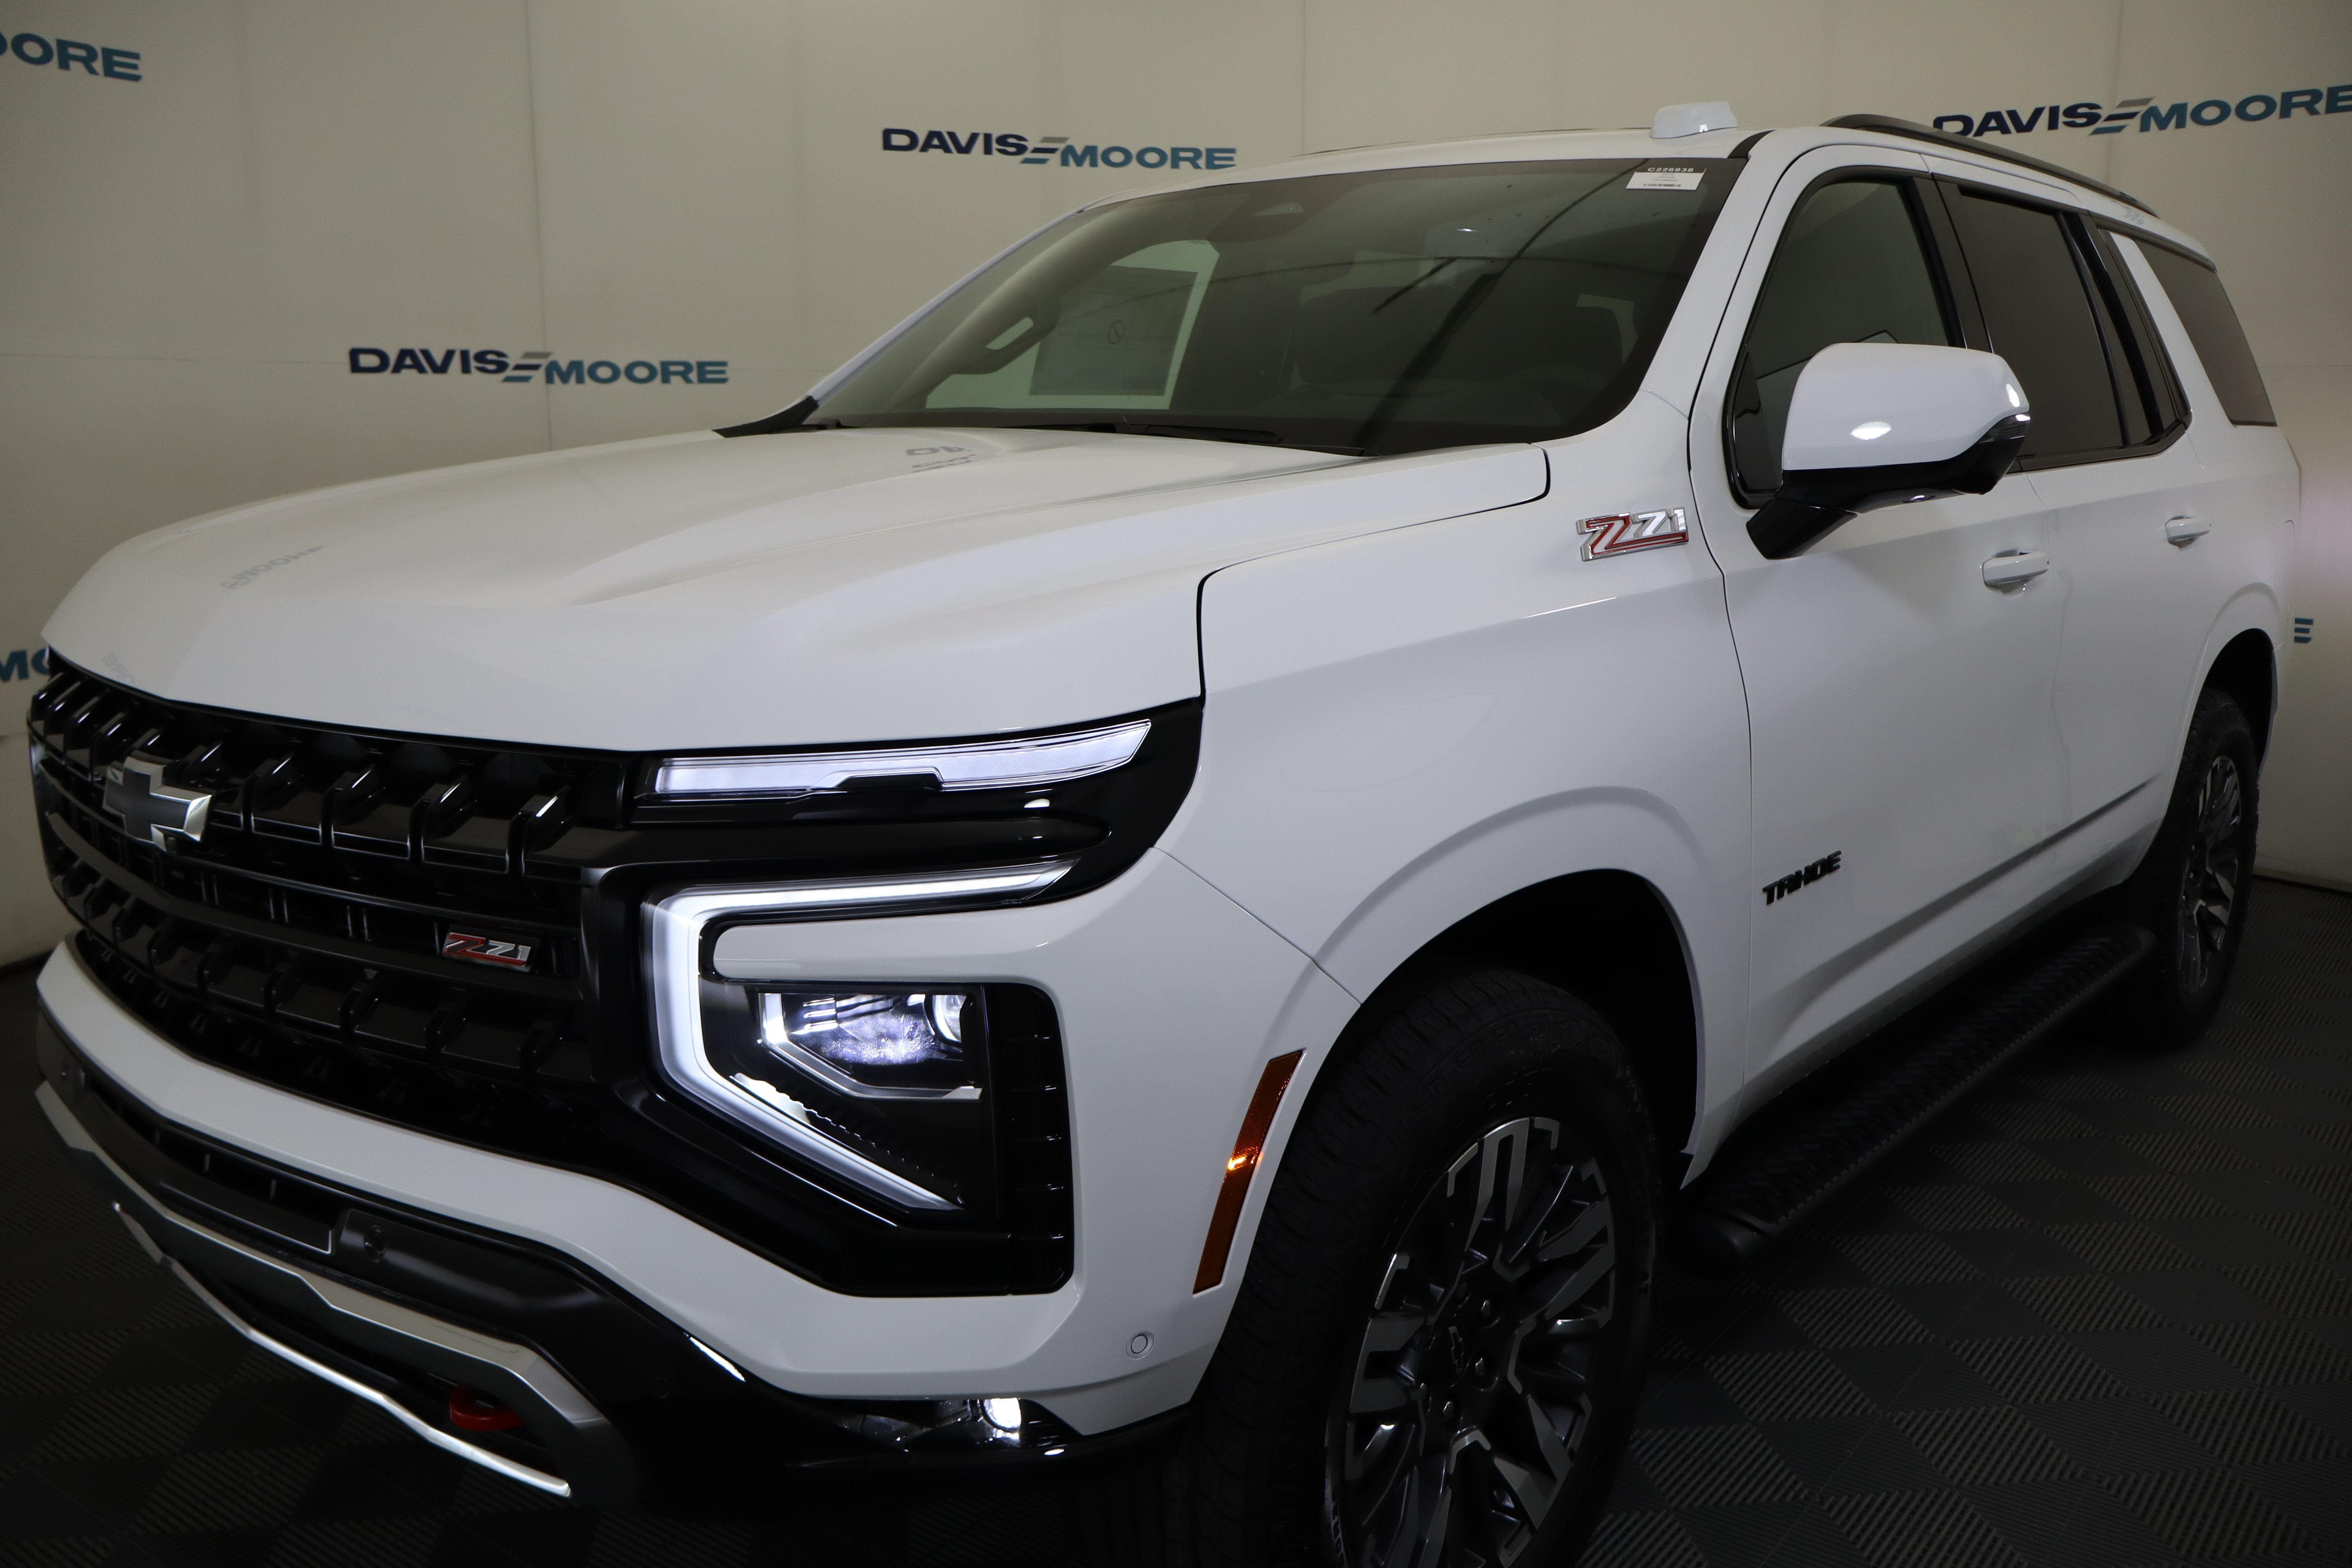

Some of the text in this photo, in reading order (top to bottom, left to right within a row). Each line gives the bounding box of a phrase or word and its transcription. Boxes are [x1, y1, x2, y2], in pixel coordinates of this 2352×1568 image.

[0, 32, 142, 82] ORE
[1932, 84, 2352, 137] DAVIS MOORE
[882, 128, 1236, 170] DAVIS MOORE
[349, 347, 729, 385] DAVIS MOORE
[1576, 506, 1689, 561] Z71
[1762, 851, 1842, 905] TAHOE
[443, 932, 532, 969] Z71
